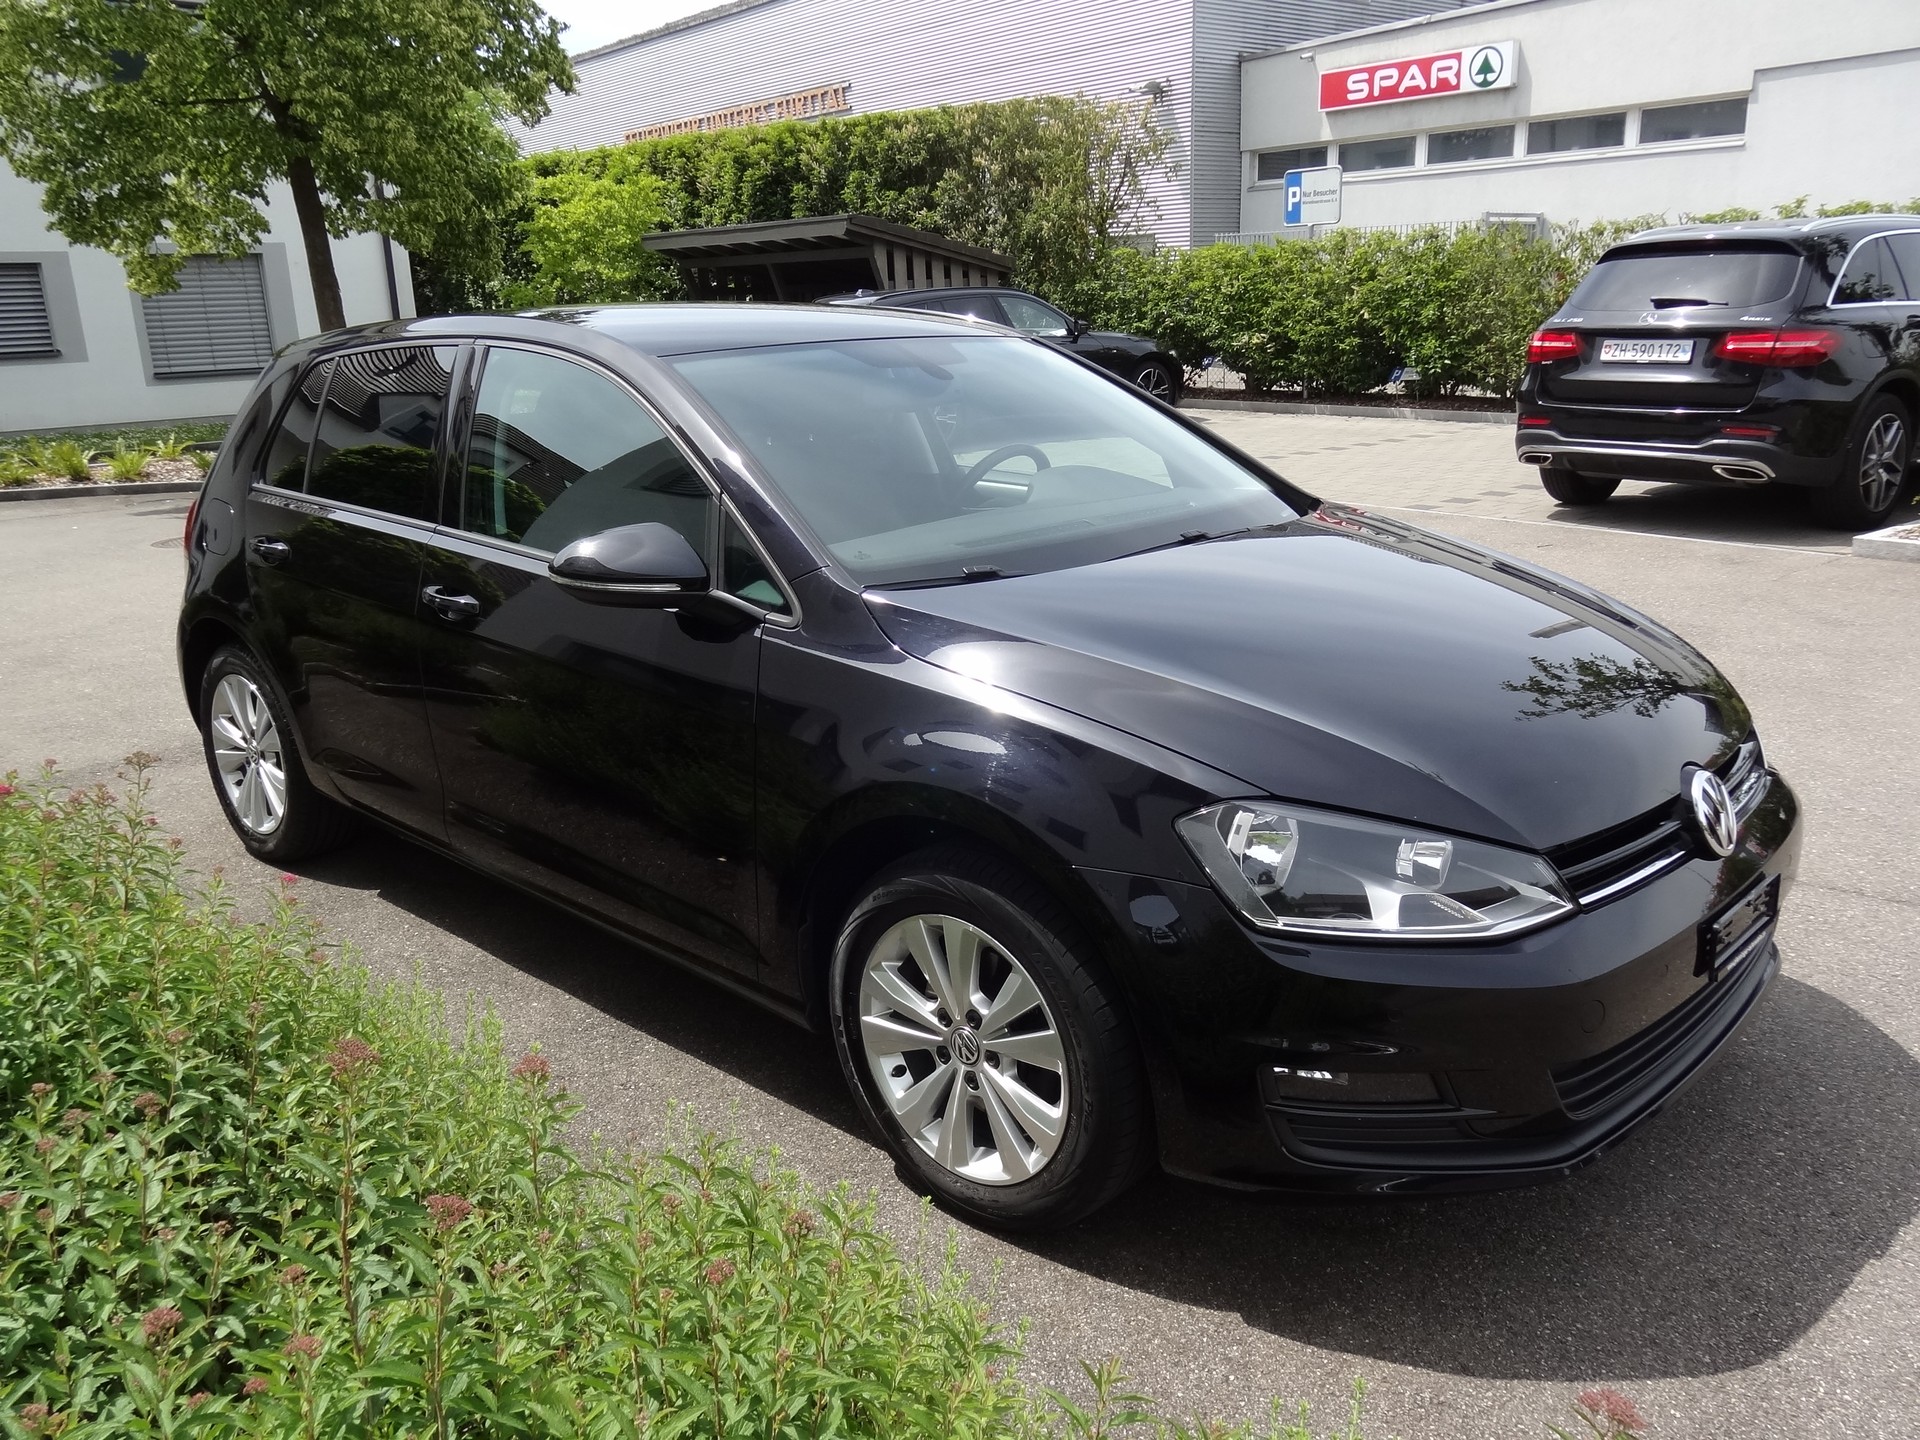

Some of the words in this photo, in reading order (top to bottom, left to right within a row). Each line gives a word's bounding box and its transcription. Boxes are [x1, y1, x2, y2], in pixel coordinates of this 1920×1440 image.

[1346, 58, 1459, 101] SPAR
[1288, 186, 1301, 212] P
[1302, 190, 1312, 198] Nur
[1313, 188, 1338, 197] Besucher
